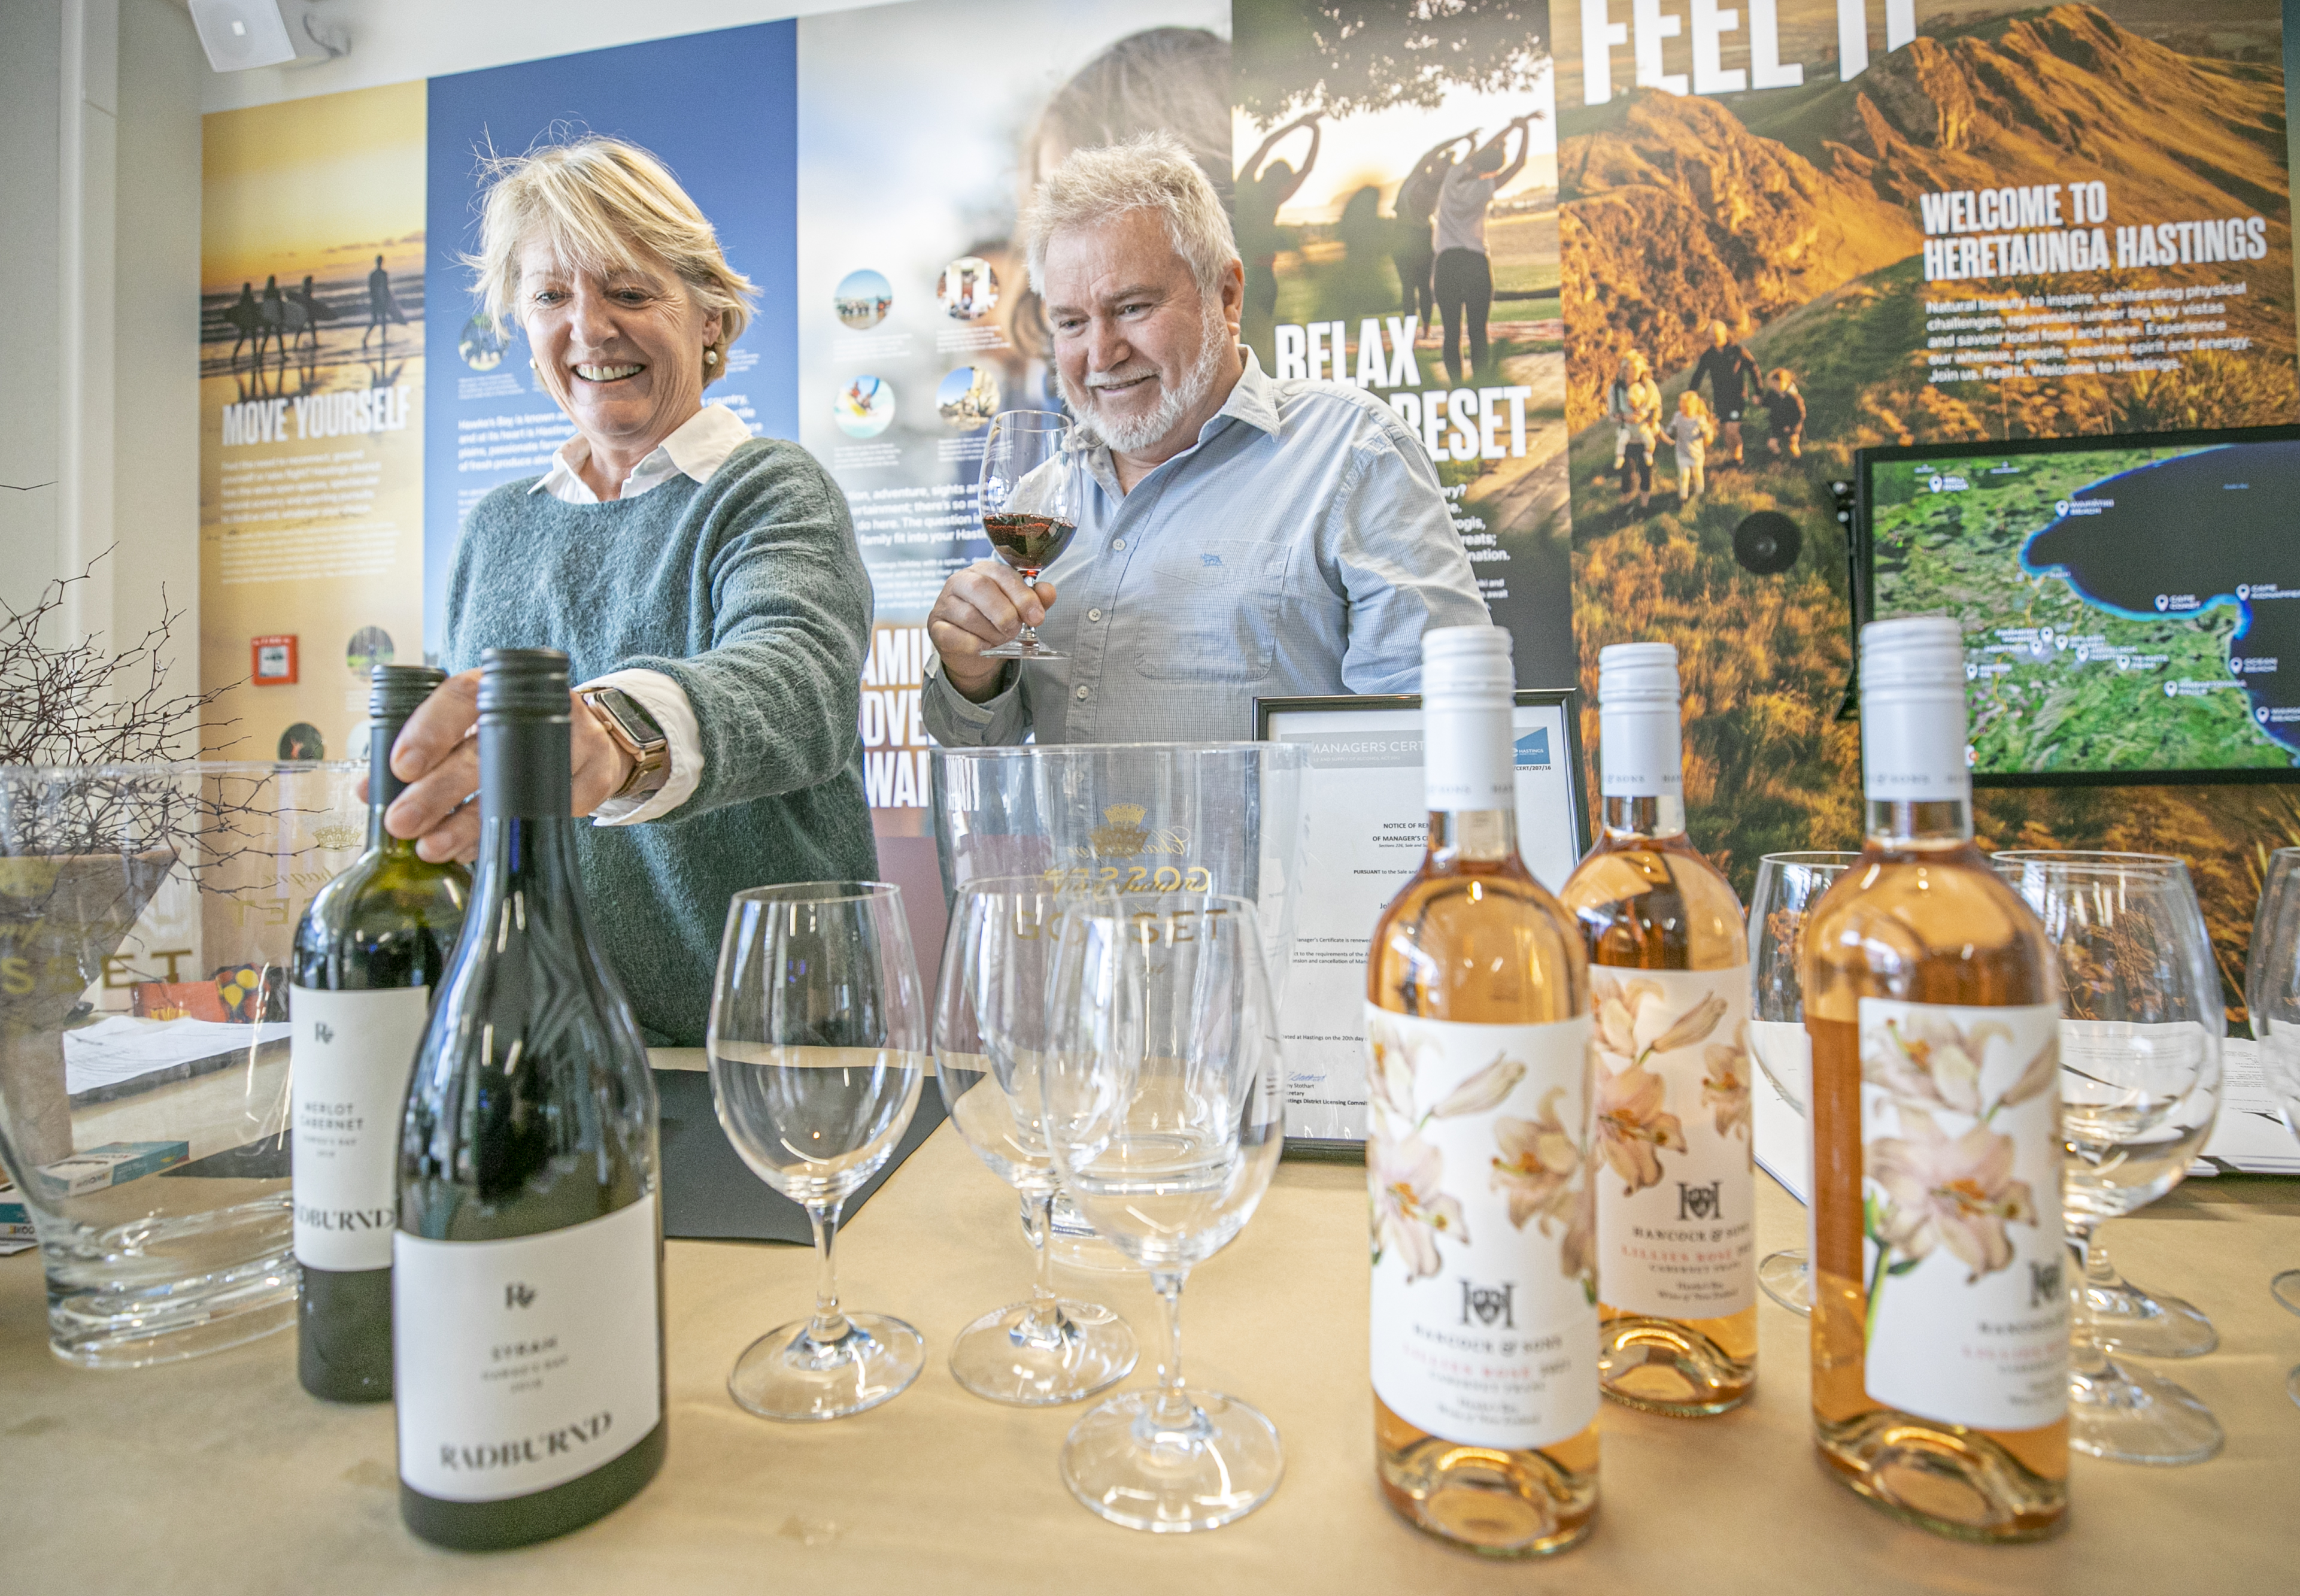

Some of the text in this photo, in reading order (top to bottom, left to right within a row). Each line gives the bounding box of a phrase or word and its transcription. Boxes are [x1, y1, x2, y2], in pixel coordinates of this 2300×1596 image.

[1580, 0, 1804, 106] FEEL
[1920, 180, 2108, 235] WELCOME TO
[1923, 216, 2267, 281] HERETAUNGA HASTINGS
[1926, 282, 2247, 314] Natural beauty to inspire, exhilarating physical
[1926, 302, 2226, 333] challenges, rejuvenate under big sky vistas
[1928, 335, 1955, 349] and
[1956, 333, 2002, 347] savour
[2005, 330, 2040, 344] local
[2041, 328, 2074, 342] food
[2076, 326, 2102, 340] and
[2146, 320, 2228, 337] Experience
[1275, 315, 1421, 389] RELAX
[1928, 353, 1952, 366] our
[2014, 346, 2068, 363] people,
[2069, 342, 2127, 358] creative
[2129, 339, 2165, 356] spirit
[2168, 338, 2196, 352] and
[2198, 336, 2250, 353] energy.
[1928, 357, 2181, 383] Join us. Feel it. Welcome to Hastings.
[222, 396, 289, 446] MOVE
[293, 386, 411, 441] YOURSELF
[496, 415, 514, 428] Bay
[524, 411, 556, 424] known
[1389, 385, 1532, 462] RESET
[872, 487, 930, 502] adventure,
[931, 483, 965, 497] sights
[914, 499, 966, 512] there's so
[856, 520, 871, 531] do
[902, 517, 923, 529] The
[924, 513, 972, 529] question
[859, 530, 955, 547] family fit into your
[1312, 742, 1387, 754] MANAGERS
[1389, 740, 1425, 753] CERT
[304, 1102, 354, 1116] MERLOT
[1632, 1226, 1707, 1242] HANCOCK
[1711, 1228, 1724, 1243] &
[1621, 1243, 1690, 1261] LILLIES
[491, 1335, 559, 1362] SYRAH
[1413, 1322, 1493, 1354] HANCOCK
[439, 1409, 614, 1471] RADBURND
